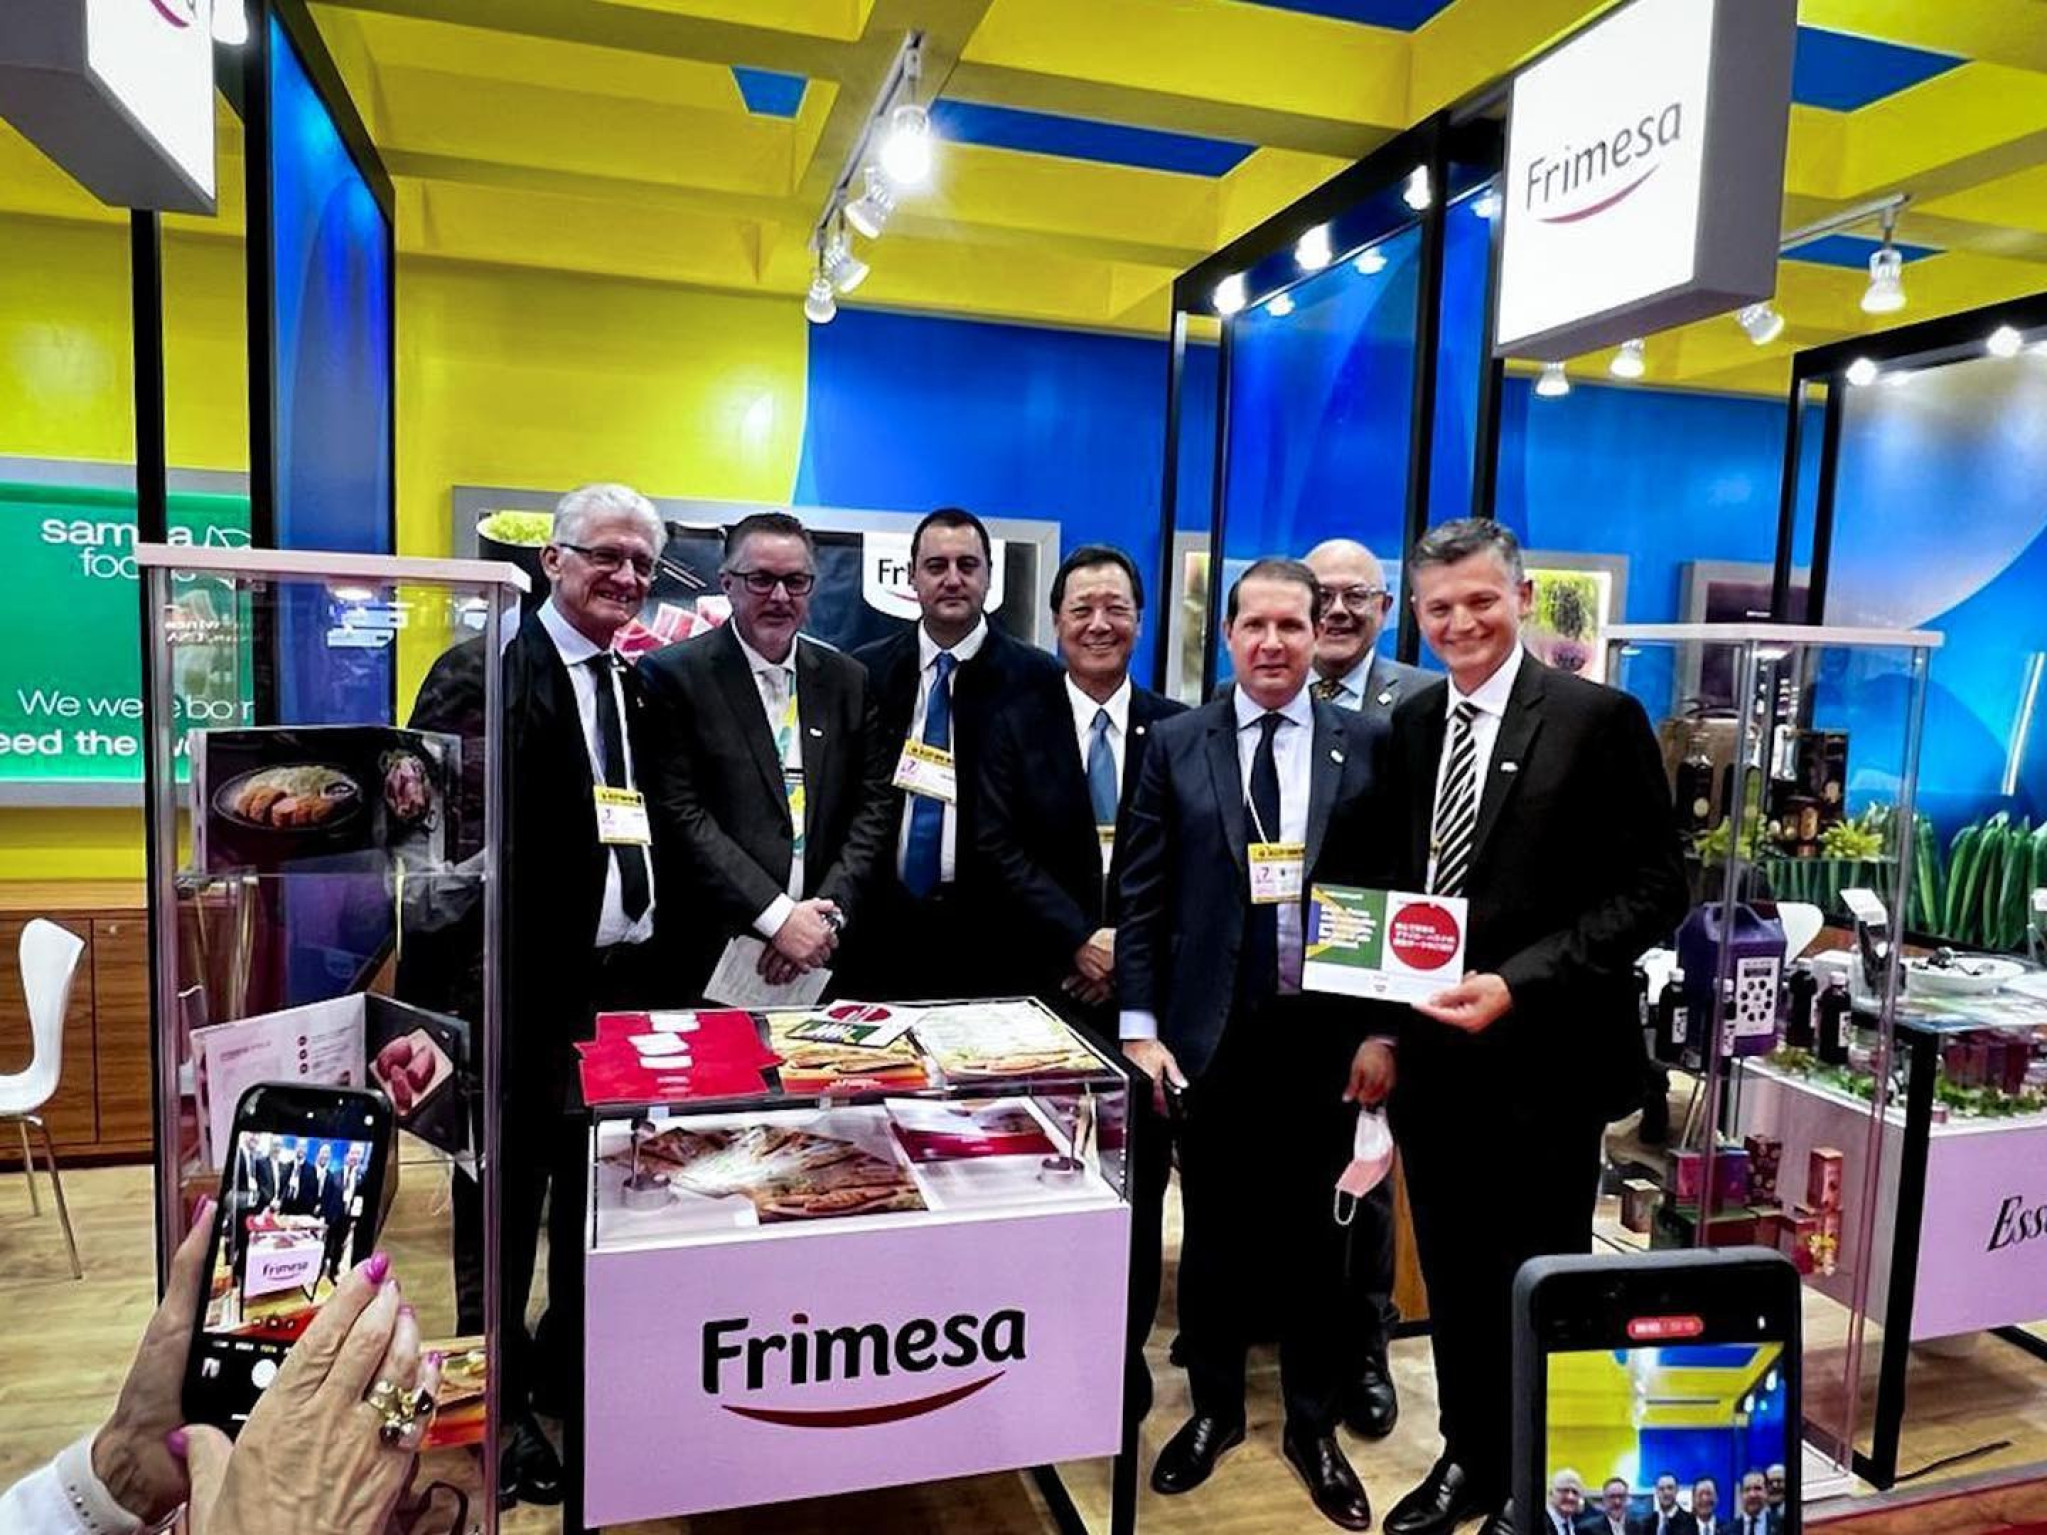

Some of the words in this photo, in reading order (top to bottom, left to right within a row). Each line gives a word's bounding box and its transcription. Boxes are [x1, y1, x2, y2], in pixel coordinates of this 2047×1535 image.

[1527, 102, 1682, 211] Frimesa
[41, 519, 194, 547] sama
[17, 688, 81, 717] We
[74, 729, 138, 756] the
[1987, 1195, 2047, 1252] Ess
[703, 1309, 1027, 1394] Frimesa
